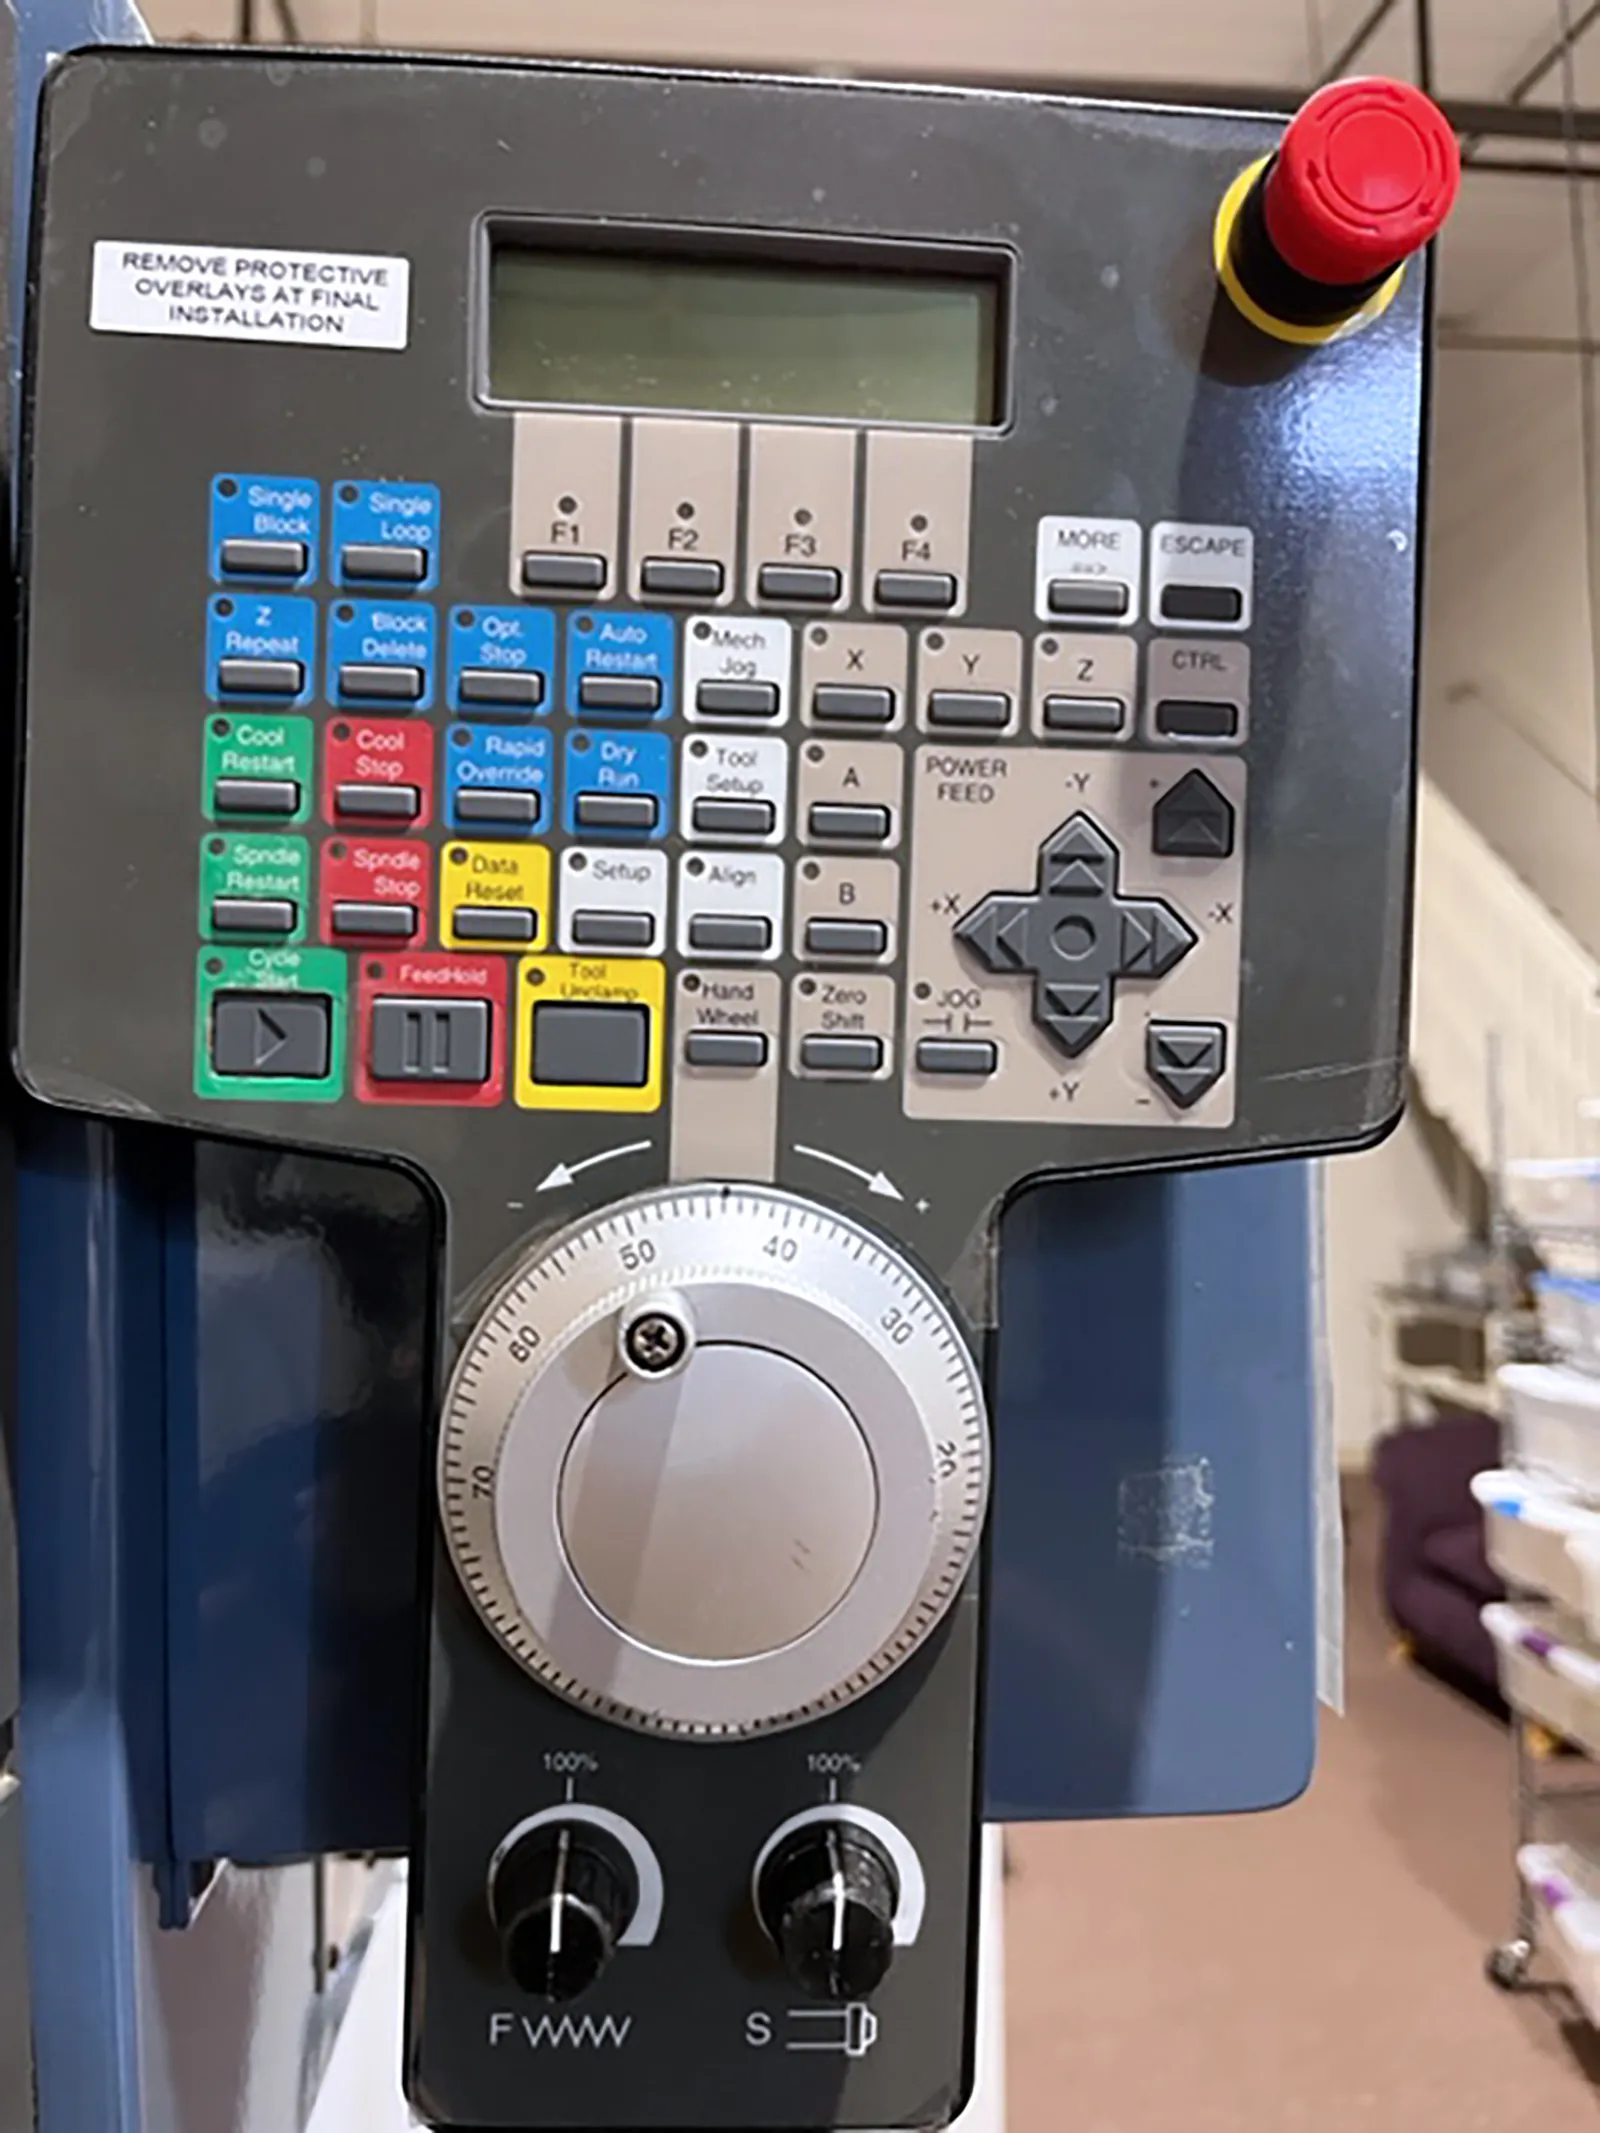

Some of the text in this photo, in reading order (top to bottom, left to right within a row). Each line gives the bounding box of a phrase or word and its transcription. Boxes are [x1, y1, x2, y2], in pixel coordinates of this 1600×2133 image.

[122, 251, 388, 287] REMOVE PROTECTIVE
[135, 278, 379, 311] OVERLAYS AT FINAL
[169, 305, 345, 333] INSTALLATION
[248, 485, 312, 512] Single
[369, 491, 433, 516] Single
[253, 513, 310, 534] Block
[381, 522, 431, 543] Loop
[551, 521, 580, 545] F1
[668, 528, 698, 552] F2
[785, 532, 817, 557] F3
[902, 539, 931, 562] F4
[1058, 529, 1122, 550] MORE
[1160, 534, 1246, 557] ESCAPE
[256, 605, 272, 626] Z
[372, 613, 427, 633] Block
[226, 632, 300, 656] Repeat
[600, 622, 648, 645] Auto
[712, 629, 766, 650] Mech
[362, 637, 427, 659] Delete
[480, 642, 527, 667] Stop
[585, 648, 658, 671] Restart
[719, 656, 757, 678] Jog
[846, 648, 864, 671] X
[962, 654, 980, 675] Y
[1076, 659, 1094, 681] Z
[1172, 651, 1227, 671] CTRL
[237, 724, 285, 746] Cool
[356, 729, 404, 751] Cool
[485, 735, 546, 759] Rapid
[601, 741, 638, 765] Dry
[716, 748, 758, 767] Tool
[222, 752, 295, 773] Restart
[355, 757, 403, 781] Stop
[456, 760, 544, 782] Override
[926, 755, 1007, 778] POWER
[598, 767, 639, 789] Run
[706, 773, 764, 796] Setup
[842, 766, 860, 788] A
[937, 782, 995, 803] FEED
[472, 853, 519, 874] Data
[592, 859, 652, 884] Setup
[227, 872, 300, 892] Restart
[374, 875, 420, 899] Stop
[708, 866, 757, 887] Align
[466, 881, 524, 901] Reset
[838, 882, 856, 905] B
[248, 948, 302, 969] Cycle
[568, 961, 607, 980] Tool
[702, 982, 754, 1001] Hand
[821, 984, 867, 1005] Zero
[937, 989, 982, 1009] JOG
[697, 1008, 759, 1026] Wheel
[821, 1011, 866, 1030] Shift
[617, 1237, 659, 1272] 50
[762, 1236, 799, 1264] 40
[880, 1308, 914, 1346] 30
[506, 1324, 542, 1365] 60
[471, 1464, 496, 1500] 70
[542, 1752, 600, 1773] 100%
[806, 1753, 862, 1774] 100%
[745, 2013, 772, 2046] S
